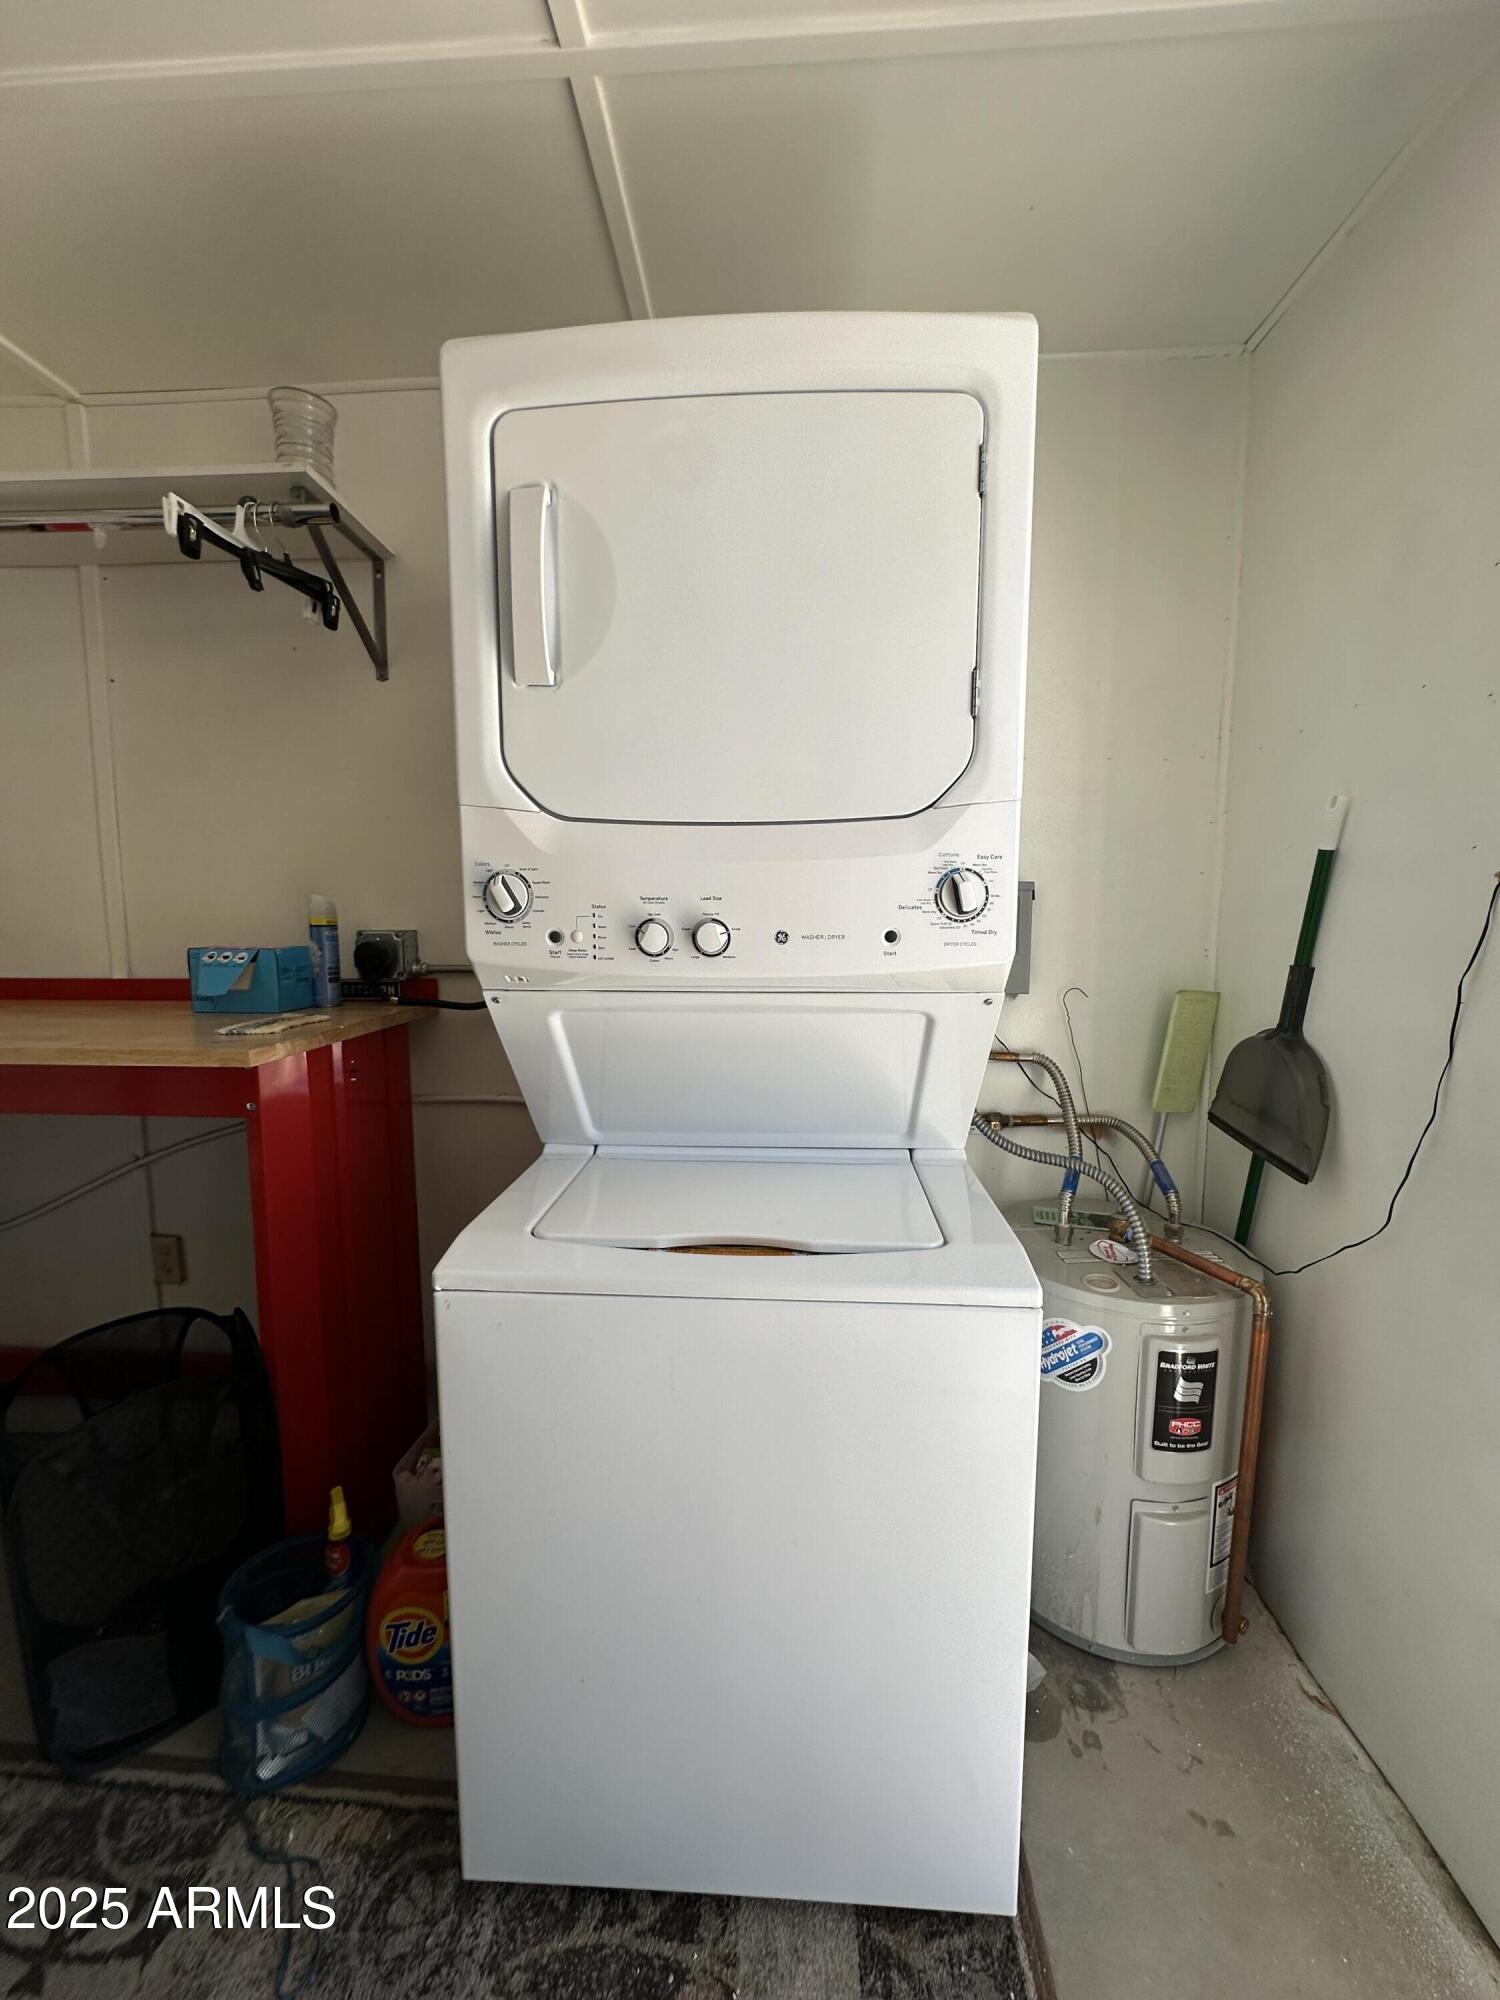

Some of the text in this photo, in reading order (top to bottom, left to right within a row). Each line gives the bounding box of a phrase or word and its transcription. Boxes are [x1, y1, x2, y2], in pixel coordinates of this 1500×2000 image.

[1159, 1361, 1217, 1370] BRADFORD WHITE
[1154, 1440, 1169, 1448] Built
[383, 1616, 438, 1656] Tide
[396, 1669, 432, 1681] PODS
